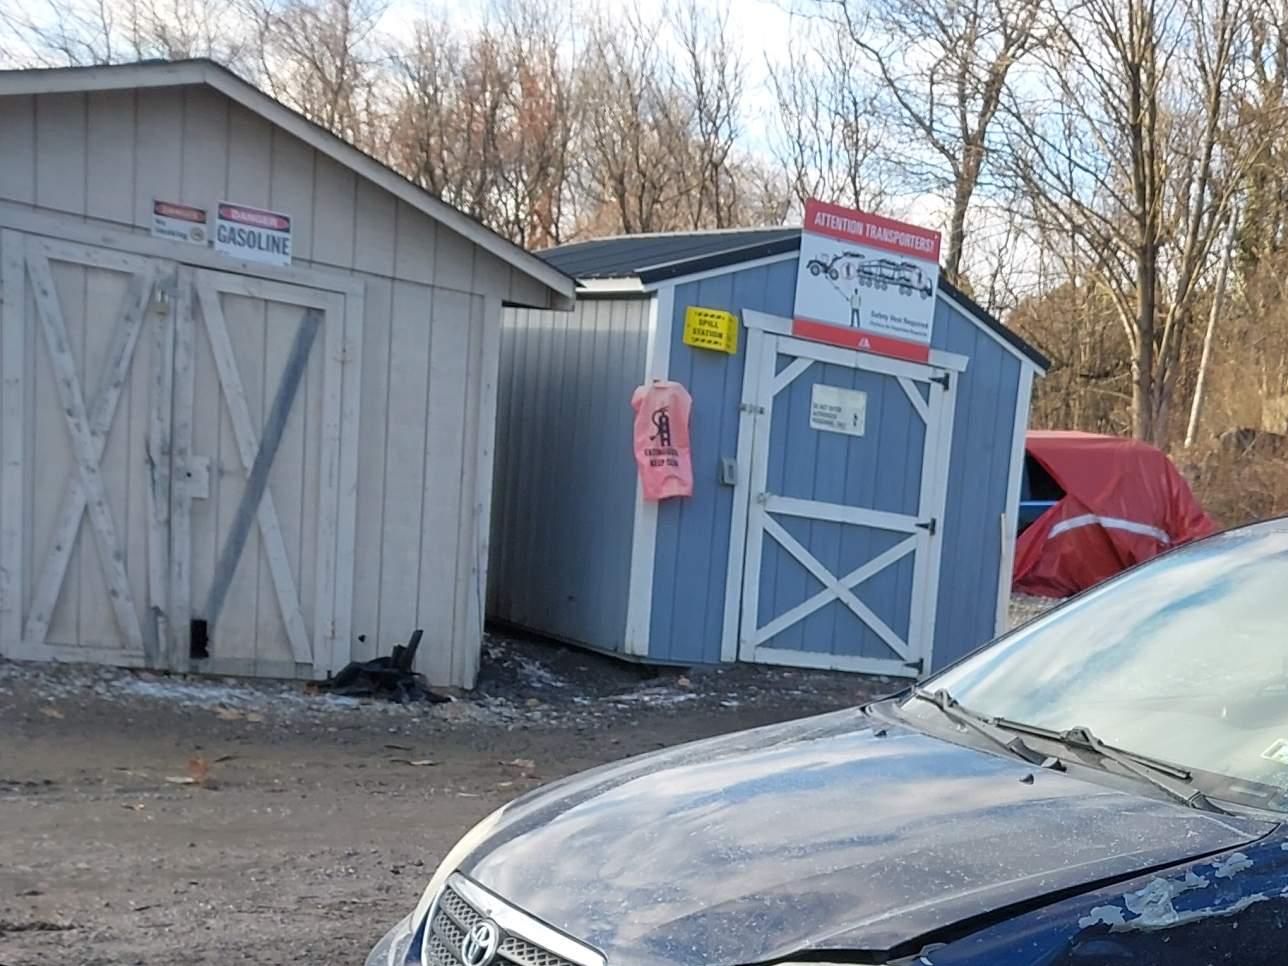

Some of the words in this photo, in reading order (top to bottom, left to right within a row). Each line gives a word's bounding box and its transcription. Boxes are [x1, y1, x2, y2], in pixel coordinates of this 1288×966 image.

[231, 208, 278, 228] DANGER
[217, 224, 290, 256] GASOLINE
[814, 211, 864, 235] ATTENTION
[865, 223, 935, 251] TRANSPORTERS!
[698, 318, 719, 328] SPILL
[692, 328, 723, 339] STATION
